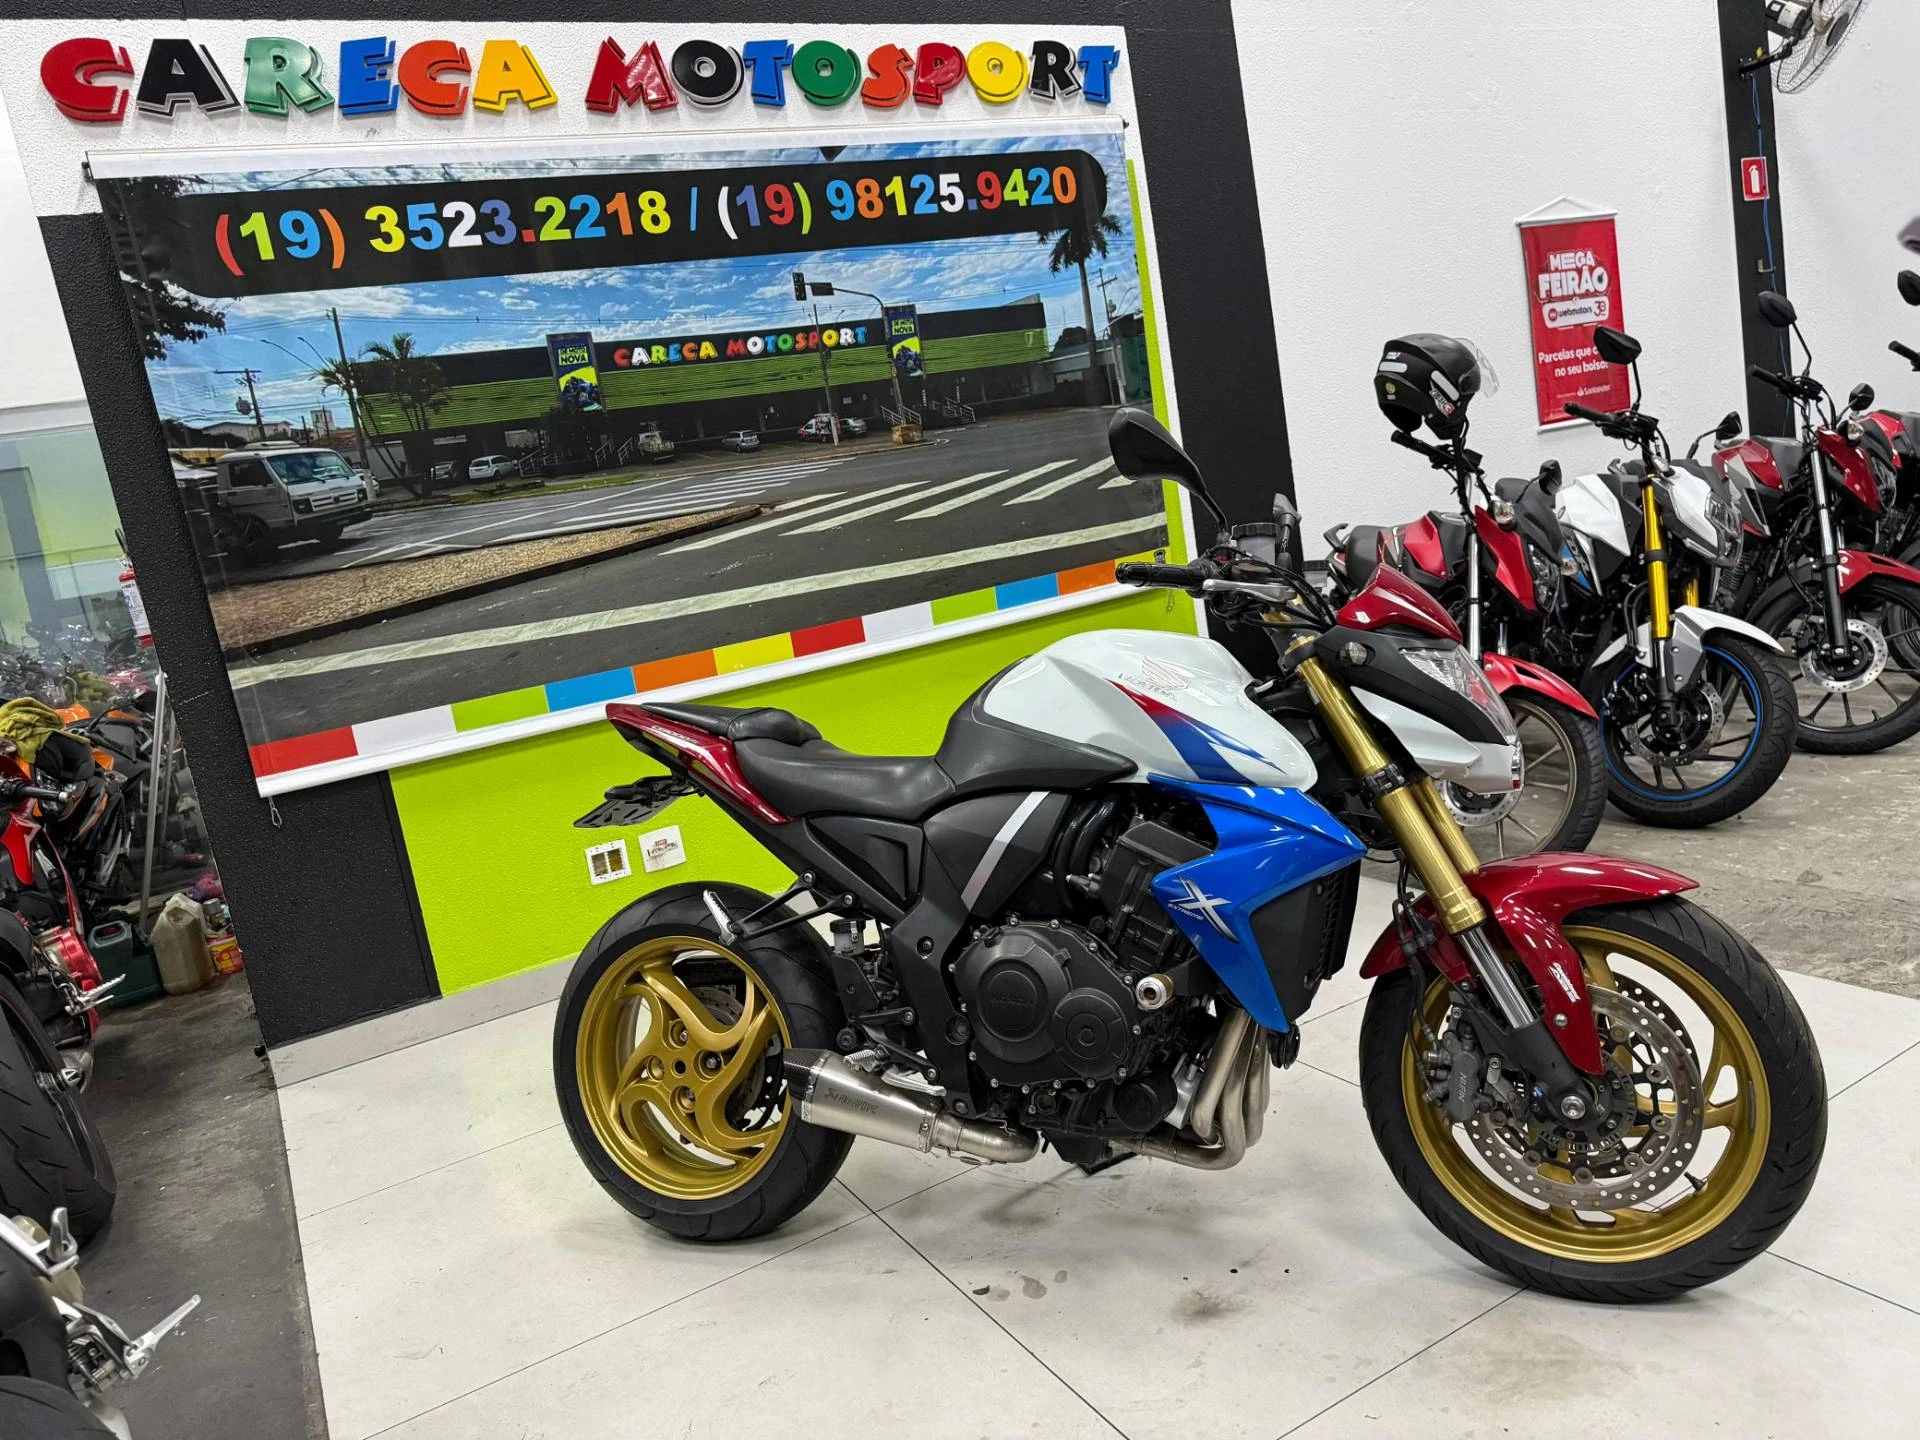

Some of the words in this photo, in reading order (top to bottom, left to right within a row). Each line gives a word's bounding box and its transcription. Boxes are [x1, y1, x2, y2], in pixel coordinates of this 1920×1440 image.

[40, 36, 558, 122] CARECA
[585, 35, 1119, 113] MOTOSPORT
[214, 208, 346, 277] (19)
[364, 190, 671, 253] 3523.2218
[717, 182, 812, 240] (19)
[826, 166, 1077, 221] 98125.9420
[1549, 250, 1595, 271] MEGA
[613, 341, 719, 367] CARECA
[726, 326, 868, 357] MOTOSPORT
[1538, 348, 1574, 365] Parcelas
[1576, 346, 1592, 360] que
[560, 353, 588, 365] NOVA
[1555, 367, 1566, 377] no
[1567, 364, 1582, 375] seu
